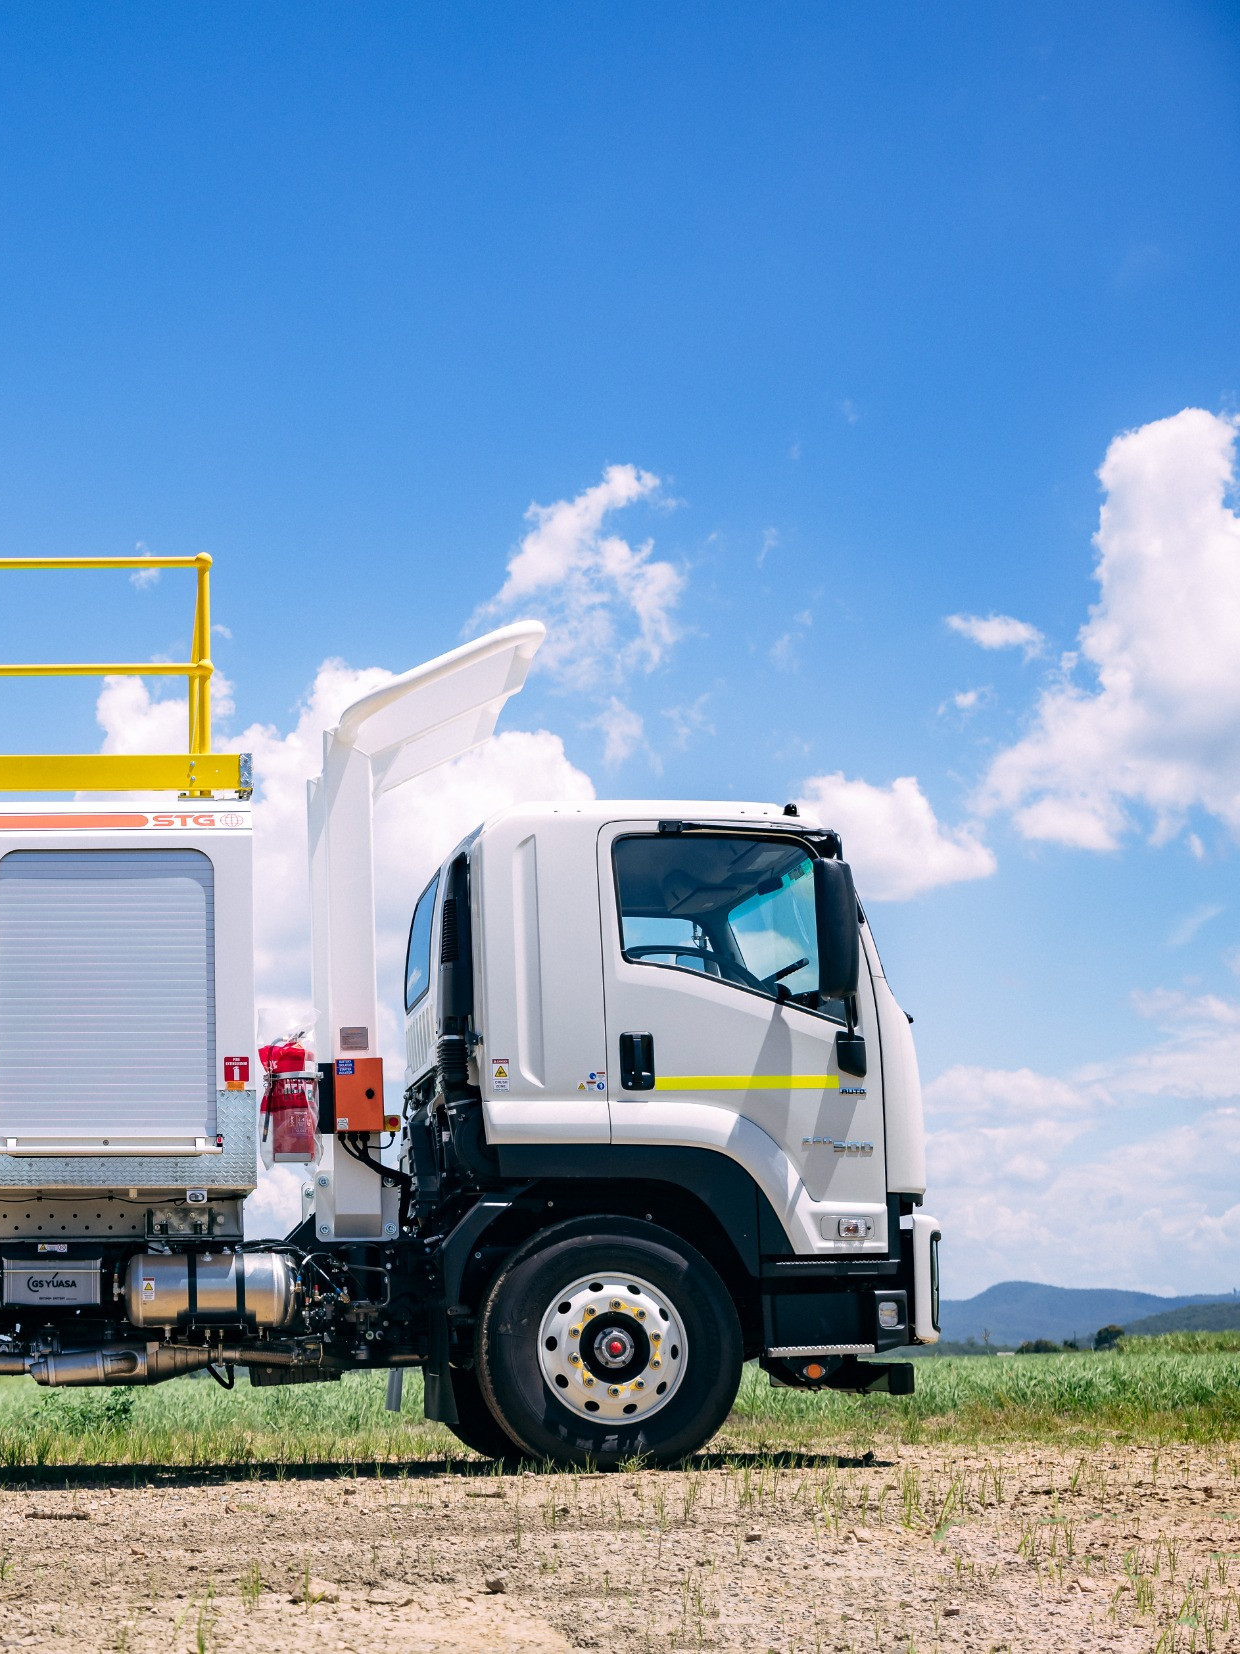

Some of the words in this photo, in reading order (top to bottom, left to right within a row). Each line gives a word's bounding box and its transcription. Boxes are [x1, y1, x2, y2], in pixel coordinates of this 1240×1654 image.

[153, 815, 215, 827] STG
[31, 1279, 44, 1288] GS
[45, 1277, 77, 1288] YUASA
